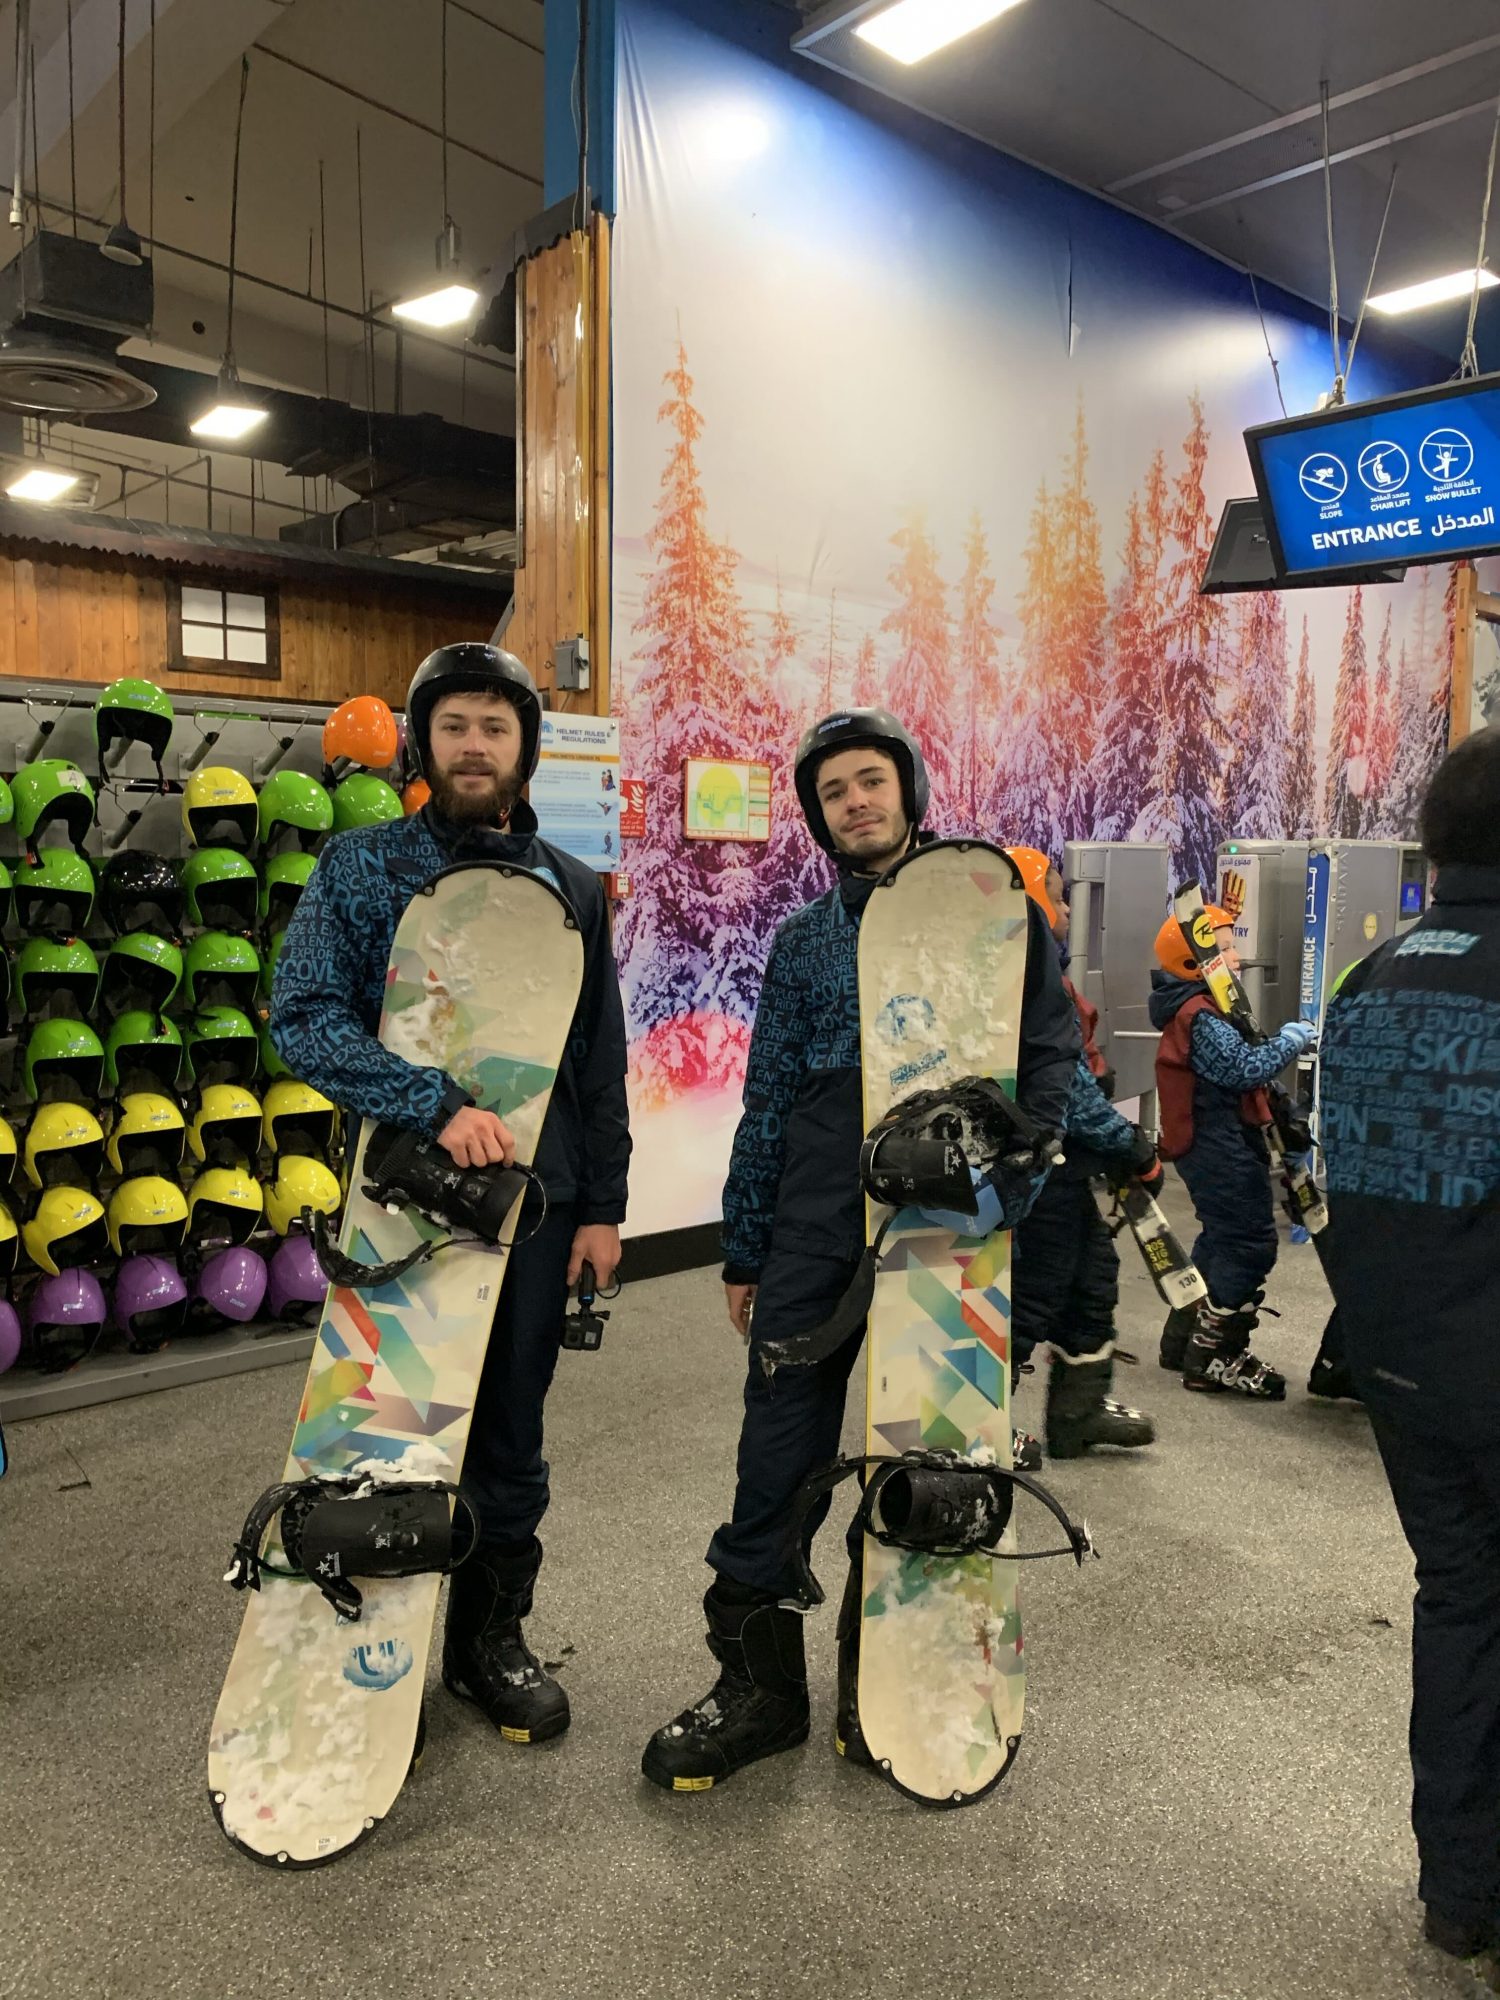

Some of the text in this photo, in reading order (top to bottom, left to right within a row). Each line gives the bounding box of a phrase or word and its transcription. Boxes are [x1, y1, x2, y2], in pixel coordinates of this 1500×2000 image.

[1425, 486, 1482, 503] SNOW BULLET
[1370, 498, 1411, 512] CHAIR LIFT
[1320, 510, 1343, 520] SLOPE
[1431, 506, 1495, 537] المدخل
[1311, 518, 1422, 549] ENTRANCE
[556, 728, 582, 736] HELMET
[584, 730, 606, 738] RULES
[561, 735, 607, 745] REGULATIONS
[1231, 927, 1249, 938] TRY
[1302, 936, 1316, 1004] ENTRANCE
[281, 979, 320, 992] ENJOY
[1364, 1007, 1404, 1029] RIDE
[301, 1040, 334, 1071] SKI
[1325, 1046, 1408, 1071] DISCOVER
[1409, 1031, 1482, 1075] SKI
[1178, 1273, 1198, 1289] 130
